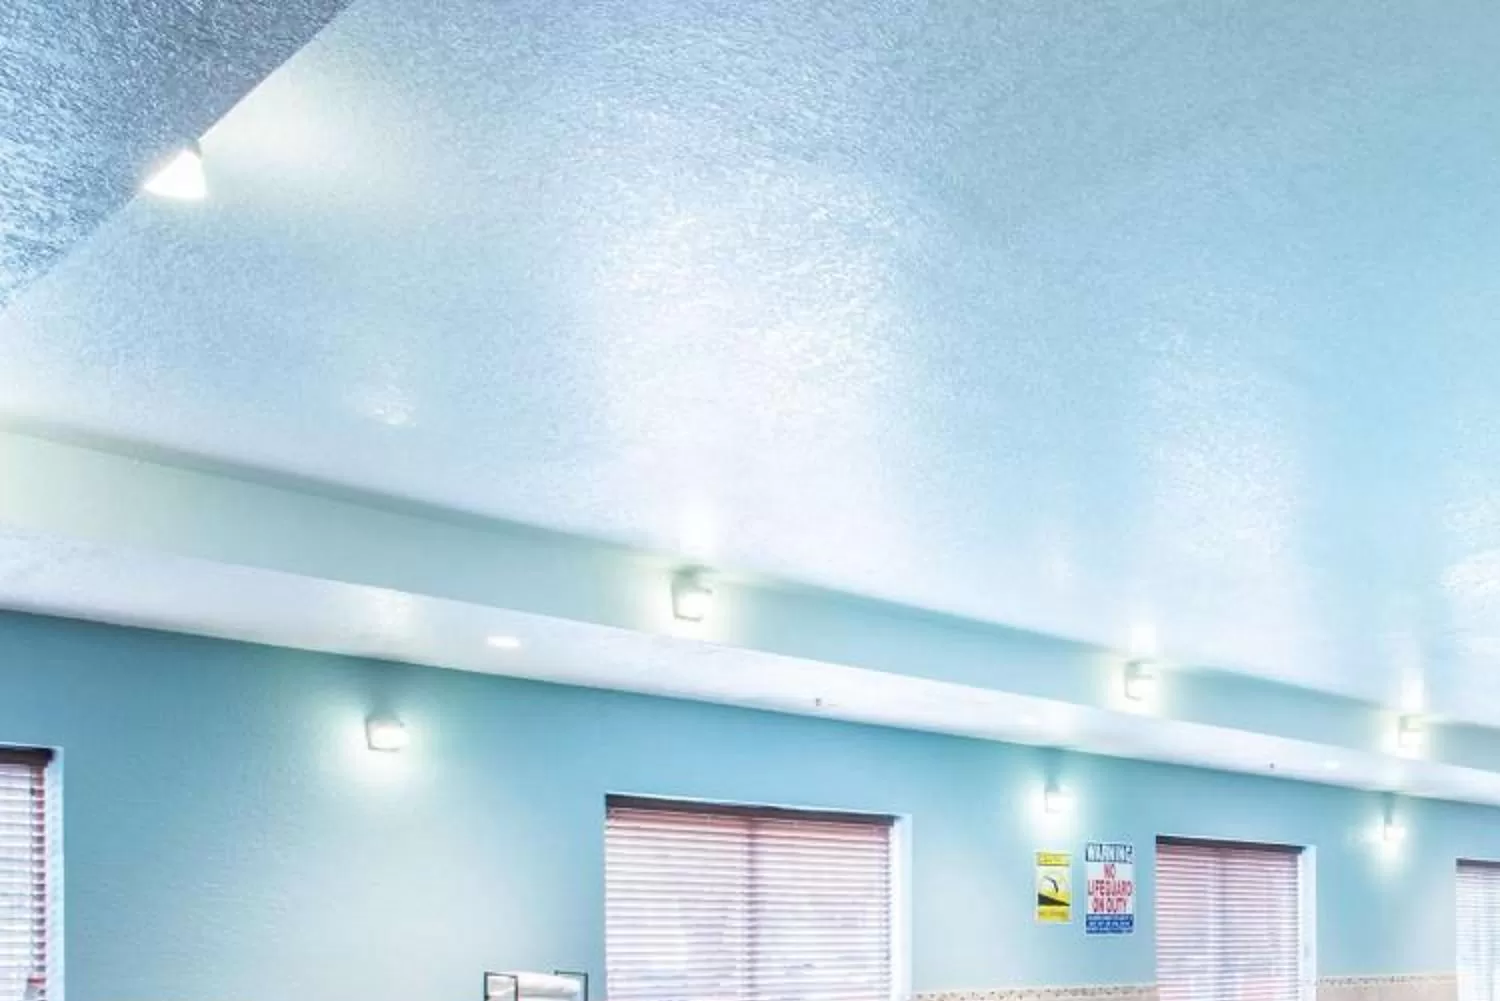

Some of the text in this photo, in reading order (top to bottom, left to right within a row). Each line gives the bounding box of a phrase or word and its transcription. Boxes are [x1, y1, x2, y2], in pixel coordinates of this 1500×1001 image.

[1103, 863, 1117, 880] NO
[1087, 879, 1133, 896] LIFEGUARD
[1092, 897, 1128, 913] ON DUTY
